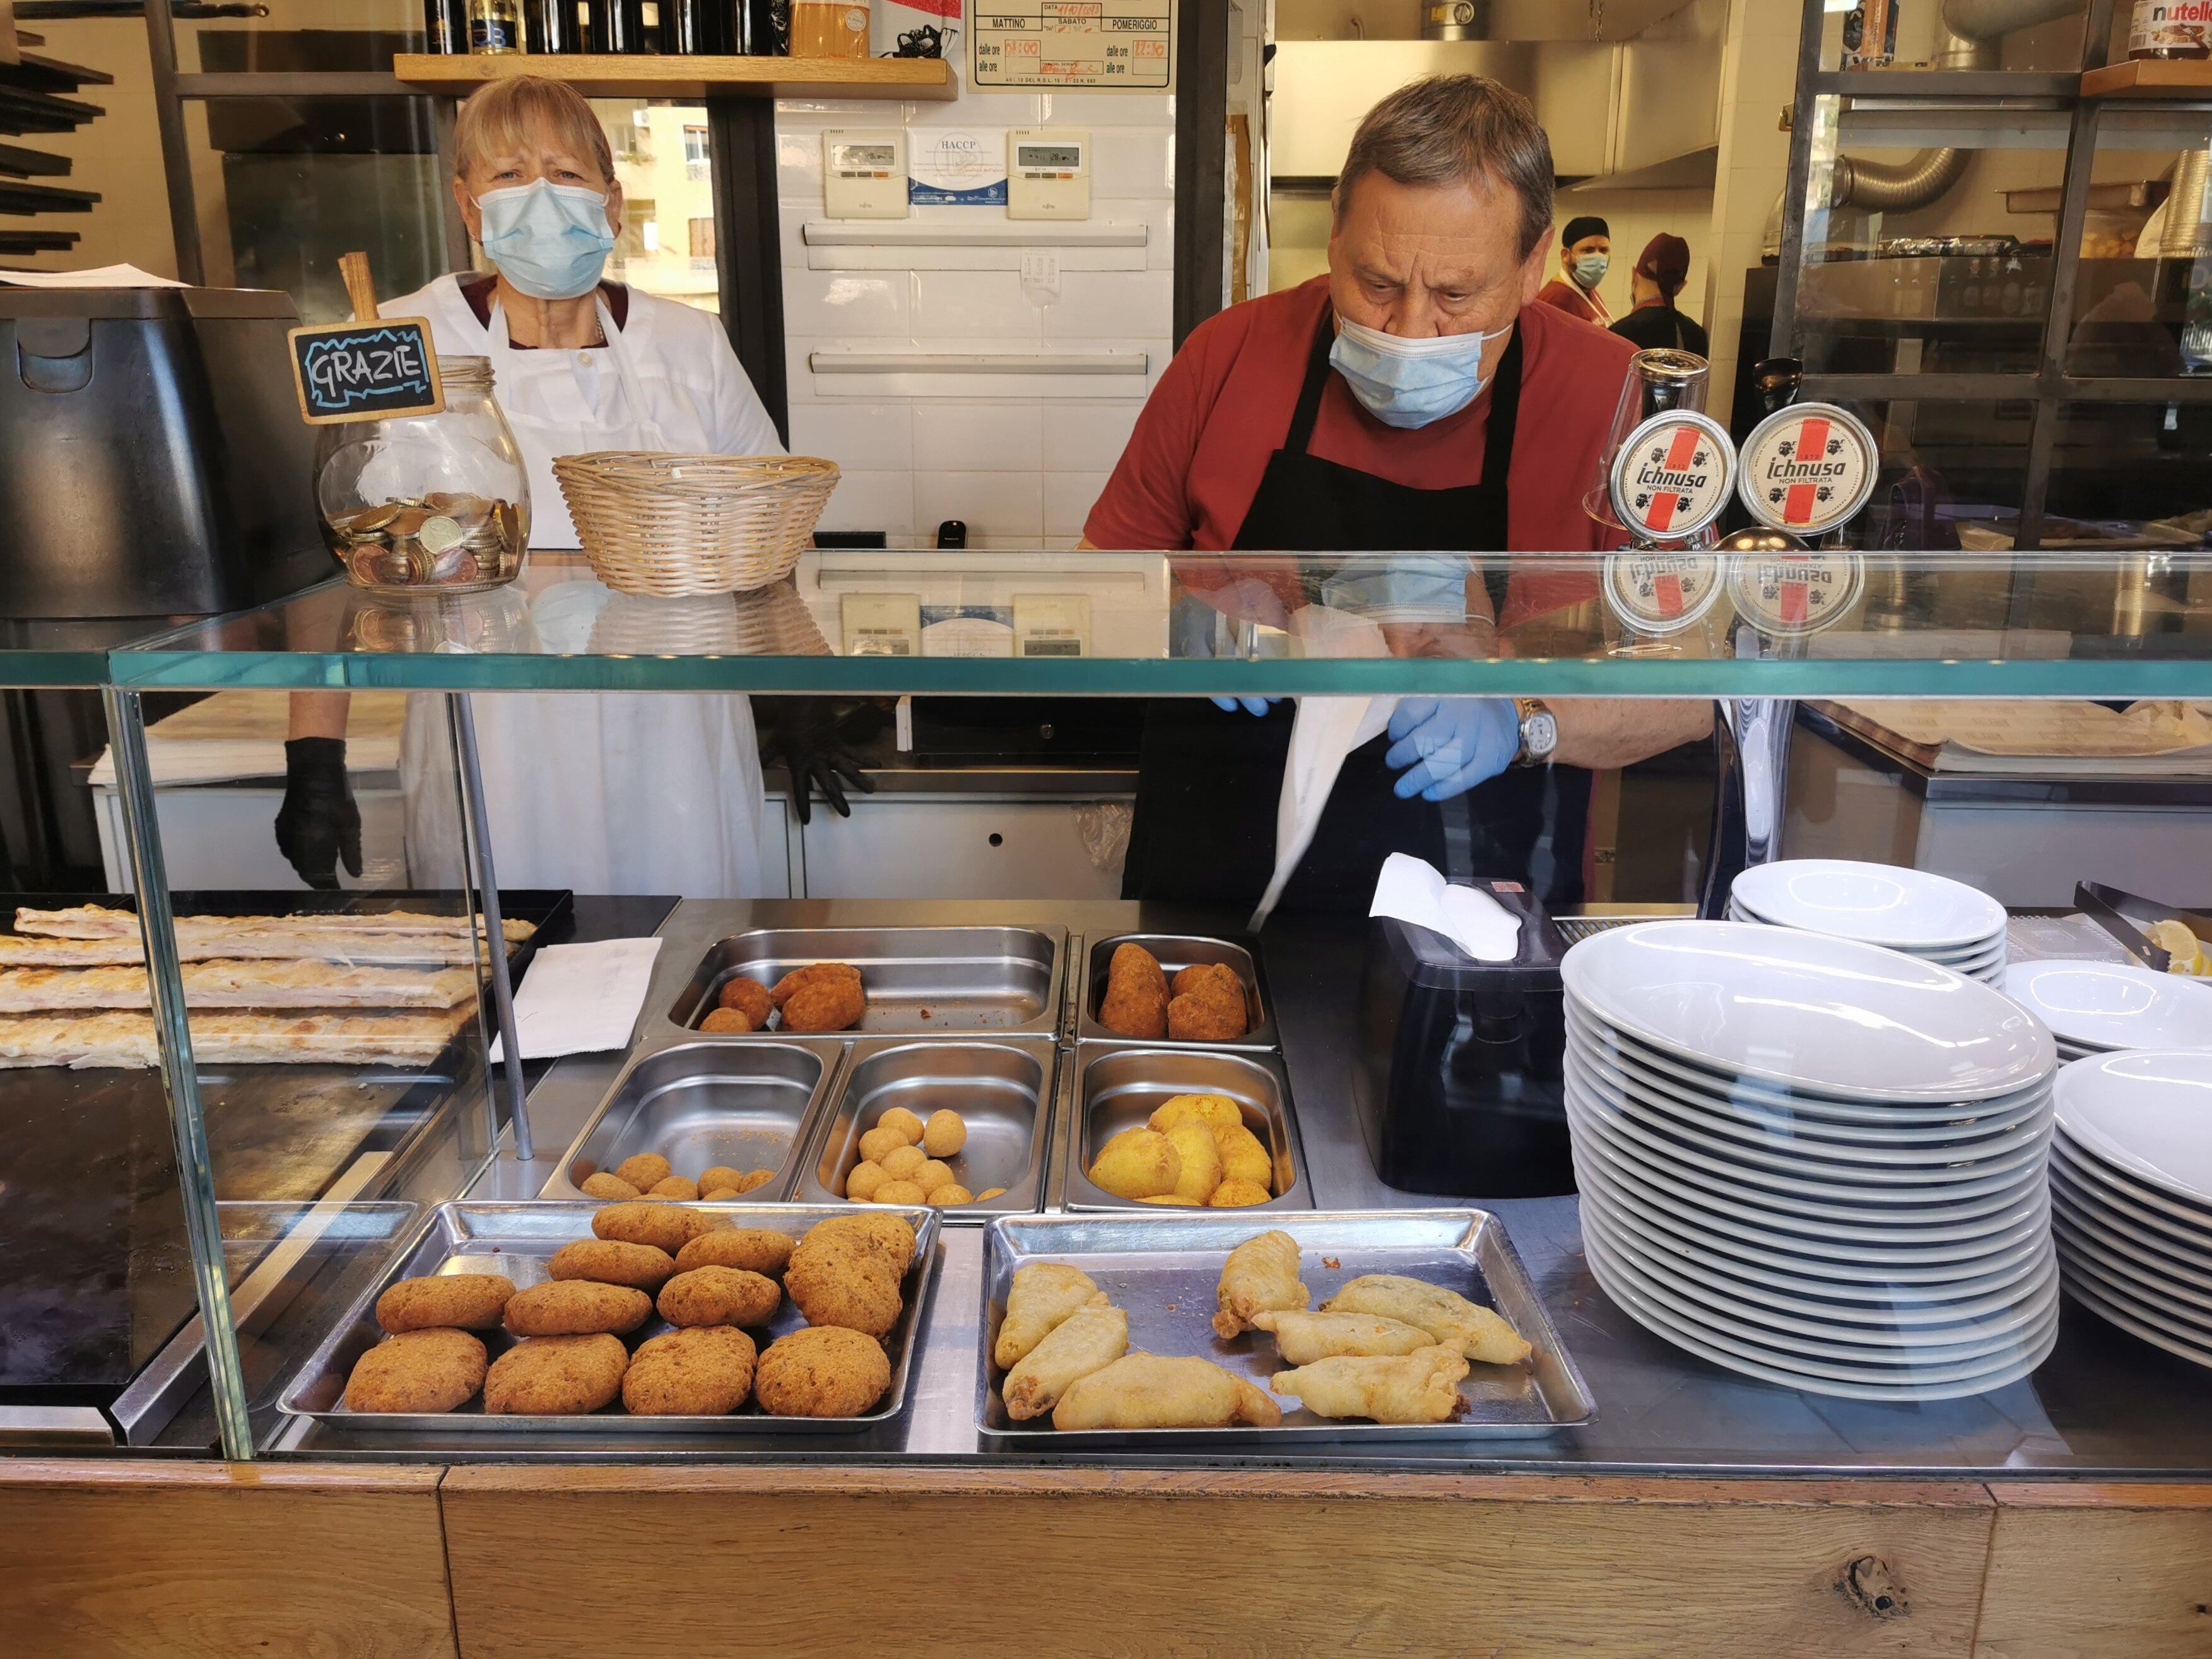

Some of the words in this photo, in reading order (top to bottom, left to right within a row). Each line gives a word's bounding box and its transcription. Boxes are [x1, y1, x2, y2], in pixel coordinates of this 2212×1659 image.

[992, 18, 1025, 28] MATTINO
[1112, 19, 1157, 30] POMERIGGIO
[979, 43, 991, 55] dalle
[992, 45, 1001, 55] ore
[1106, 45, 1119, 57] dalle
[1119, 47, 1128, 57] ore
[979, 60, 988, 72] alle
[989, 62, 997, 72] ore
[1106, 61, 1115, 73] alle
[1116, 64, 1125, 73] ore
[941, 141, 976, 149] HACCP
[312, 345, 421, 397] GRAZIE
[1767, 457, 1847, 479] ichnusa
[1637, 462, 1707, 488] ichnusa
